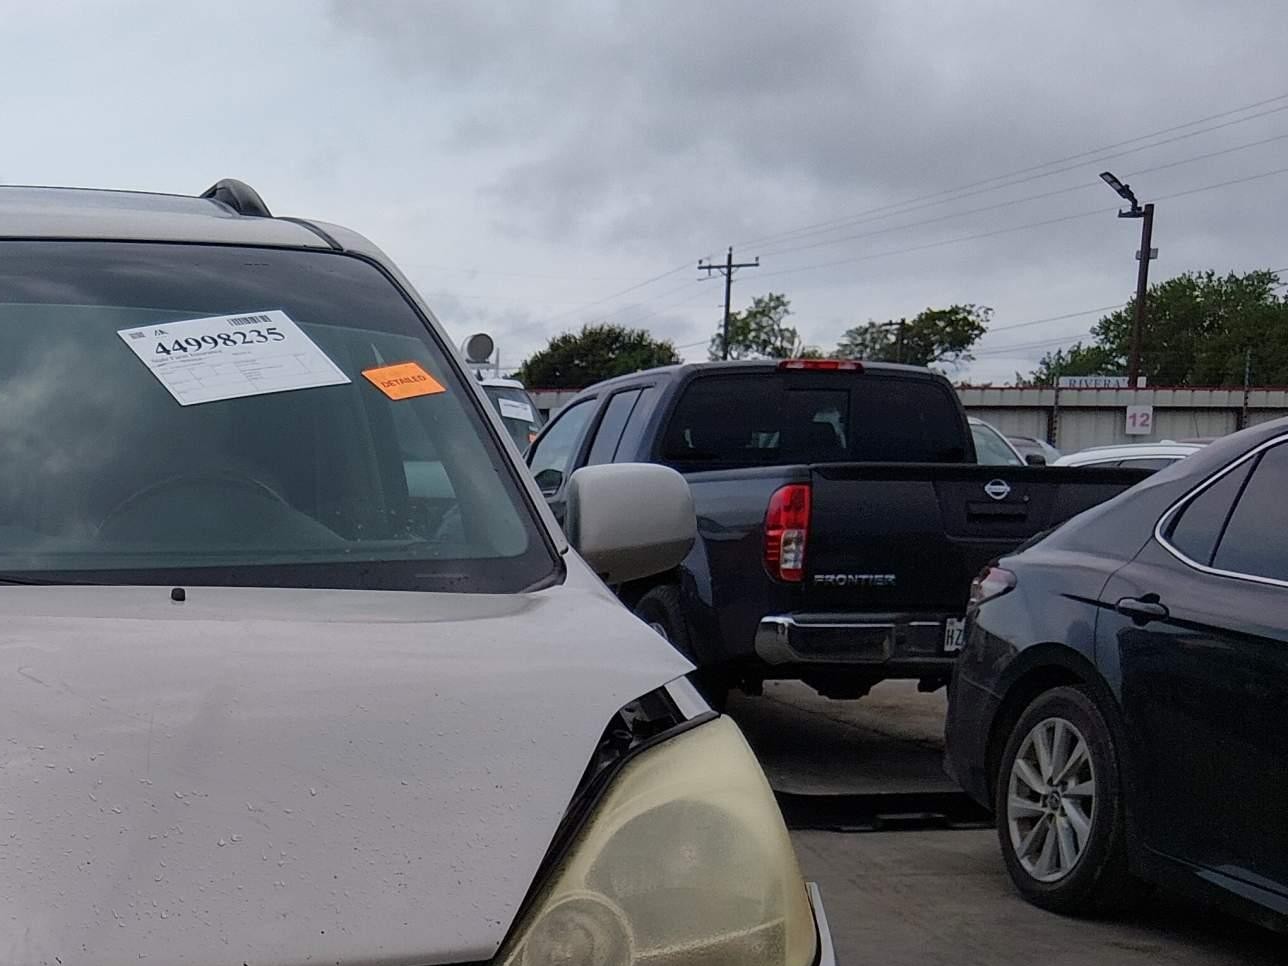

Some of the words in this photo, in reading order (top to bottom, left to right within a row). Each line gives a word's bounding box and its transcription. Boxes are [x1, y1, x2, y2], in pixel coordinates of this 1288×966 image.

[155, 327, 286, 356] 44998235
[381, 375, 426, 388] DETAILED
[1128, 412, 1150, 428] 12
[814, 574, 896, 586] FRONTIER
